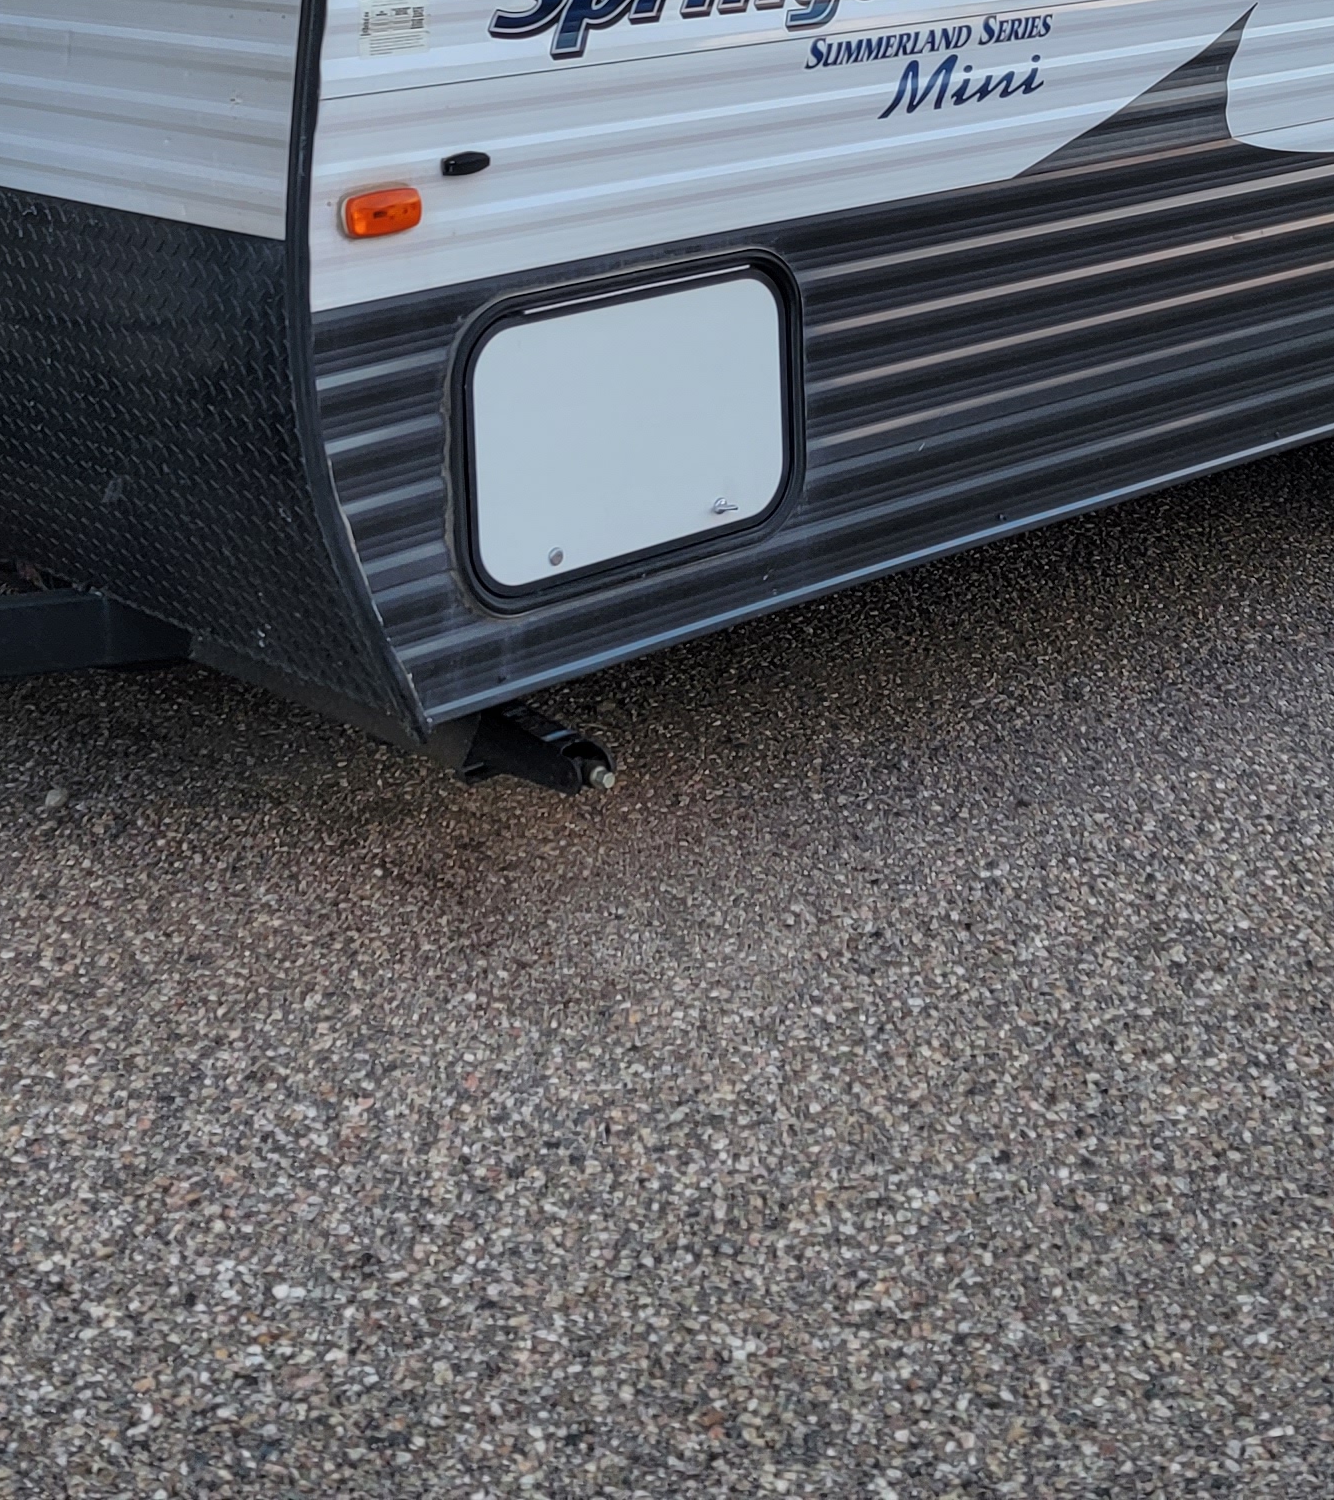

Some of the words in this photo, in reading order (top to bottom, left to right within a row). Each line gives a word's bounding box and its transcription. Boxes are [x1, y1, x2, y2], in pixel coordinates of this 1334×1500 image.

[804, 25, 973, 71] SUMMERLAND
[978, 13, 1054, 47] SERIES
[877, 53, 1046, 120] Mini
